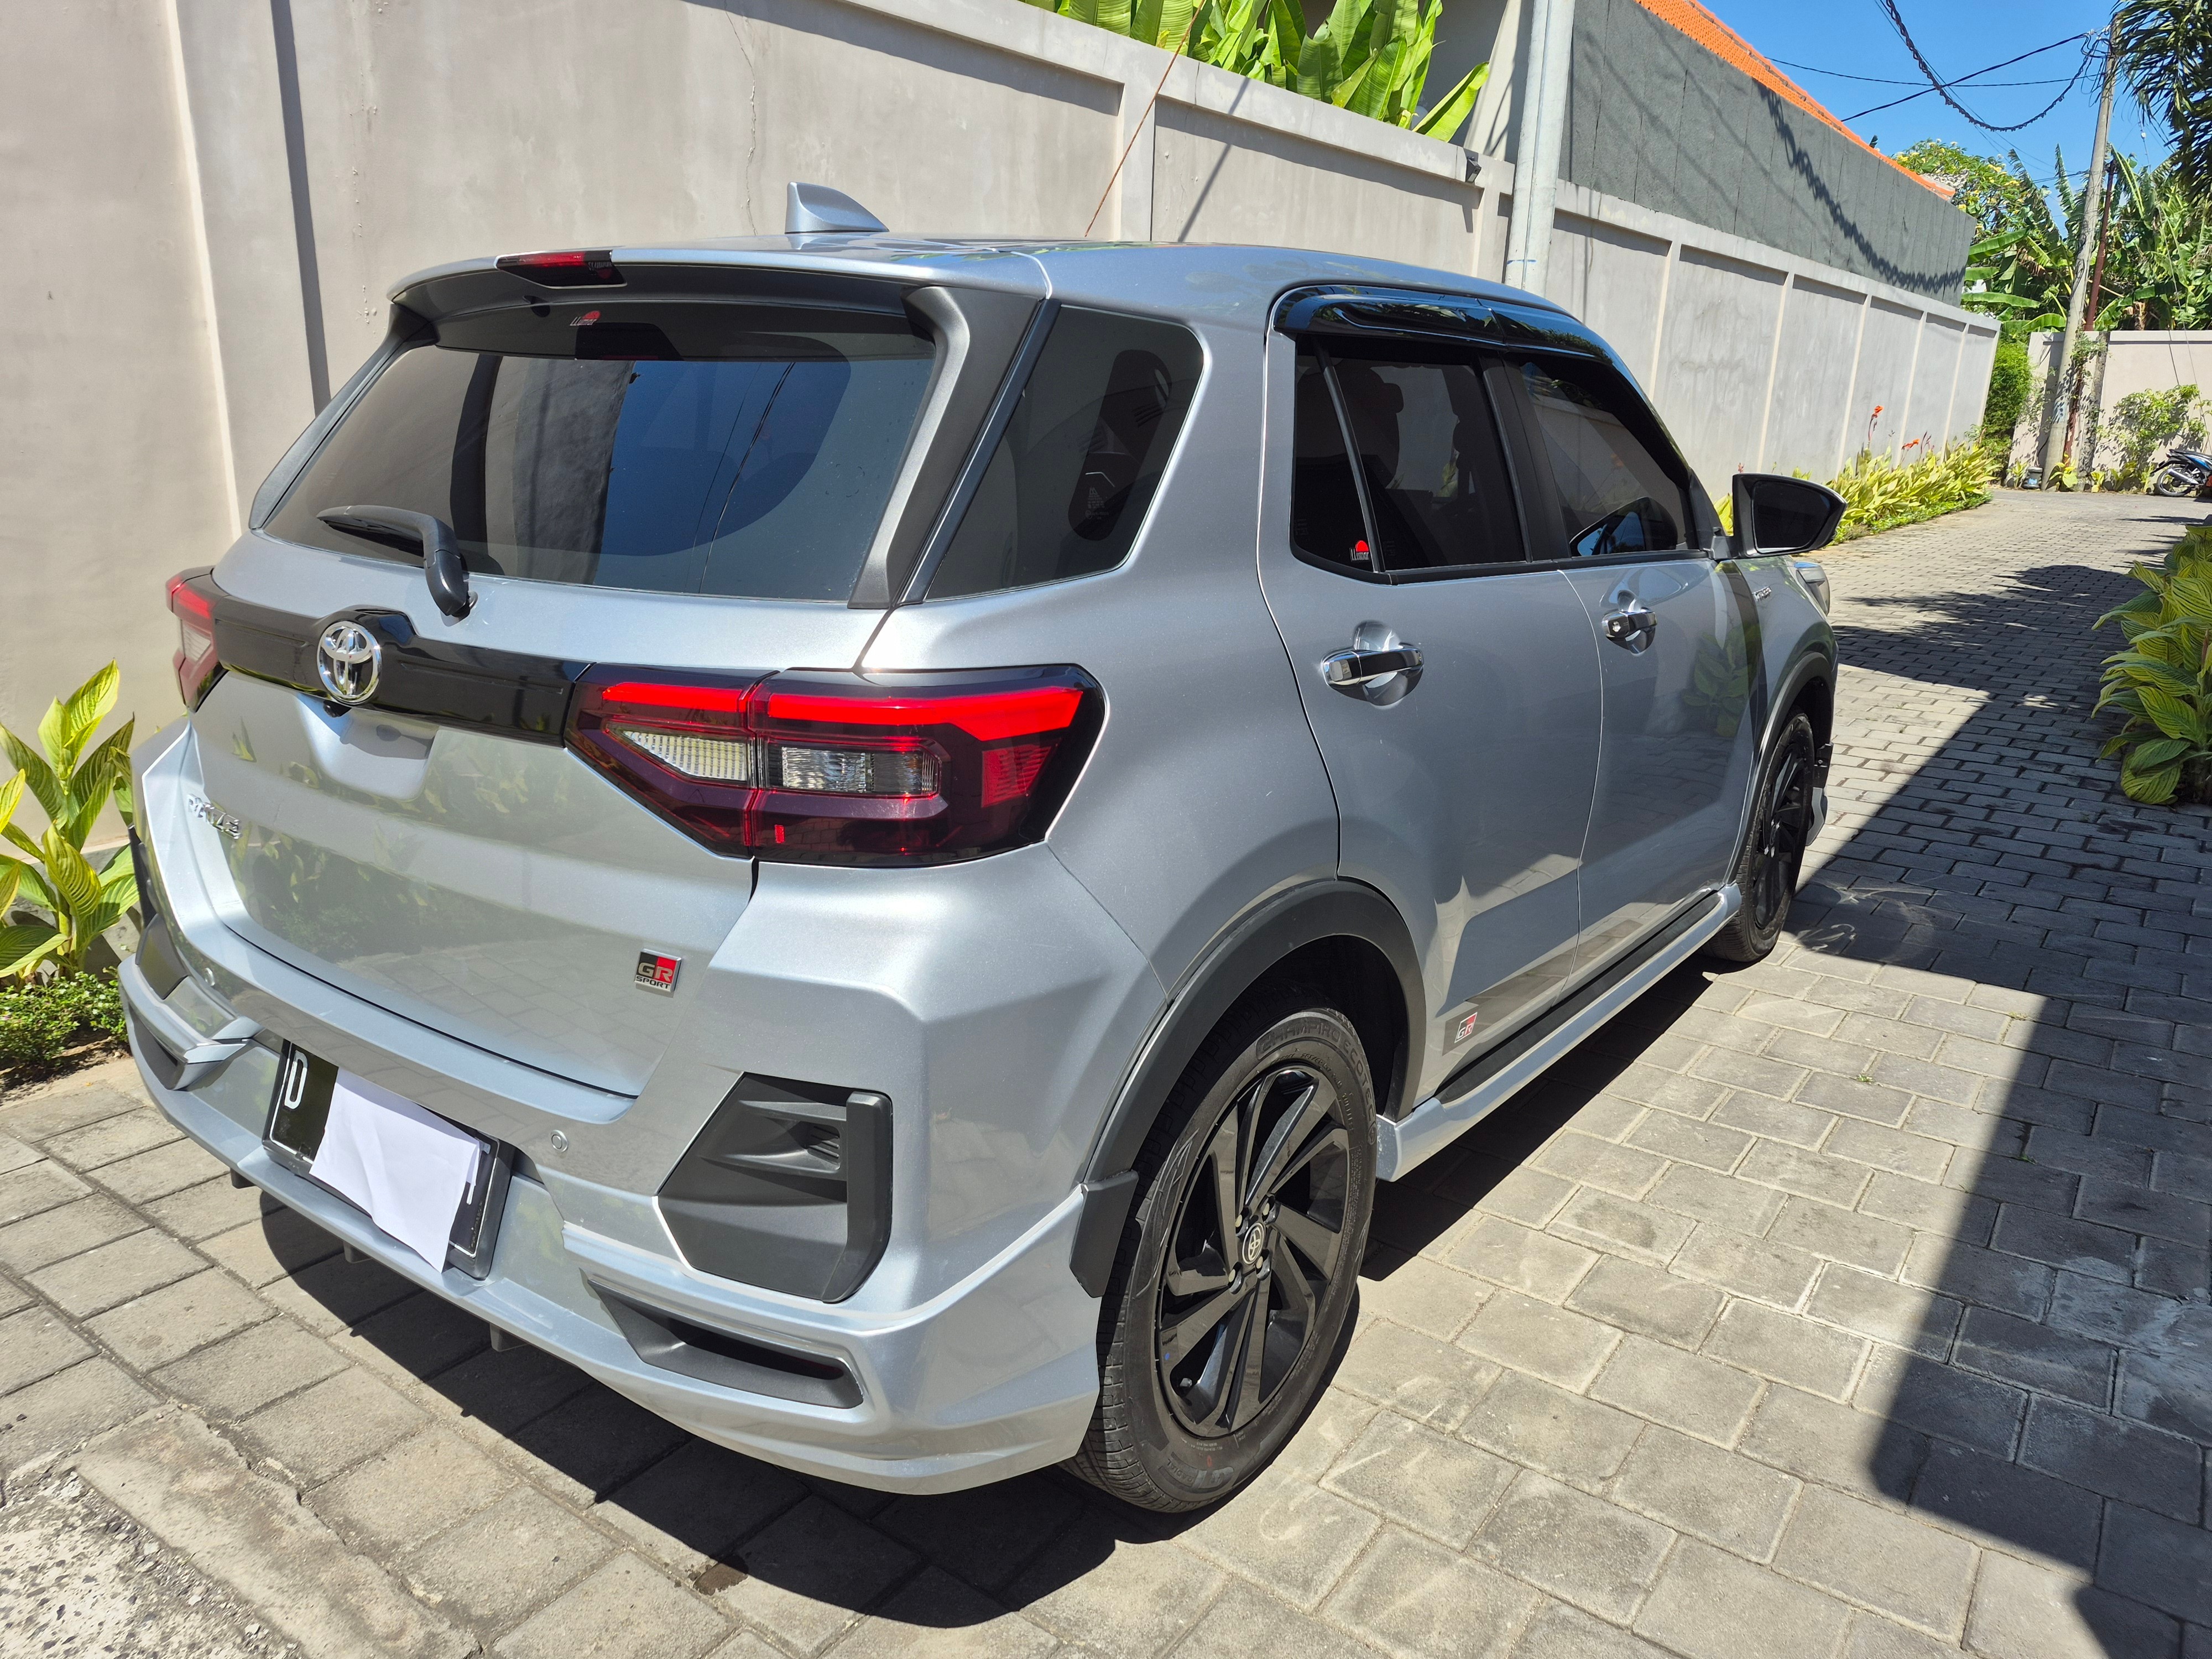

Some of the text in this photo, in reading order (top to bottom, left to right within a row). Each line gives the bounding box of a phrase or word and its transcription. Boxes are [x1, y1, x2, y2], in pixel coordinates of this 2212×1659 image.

[636, 976, 671, 989] SPORT
[638, 962, 674, 983] GR
[1457, 1022, 1474, 1040] GR
[284, 1050, 308, 1110] D
[1343, 1039, 1375, 1122] ECOTEC
[1167, 1458, 1193, 1484] RADIAL
